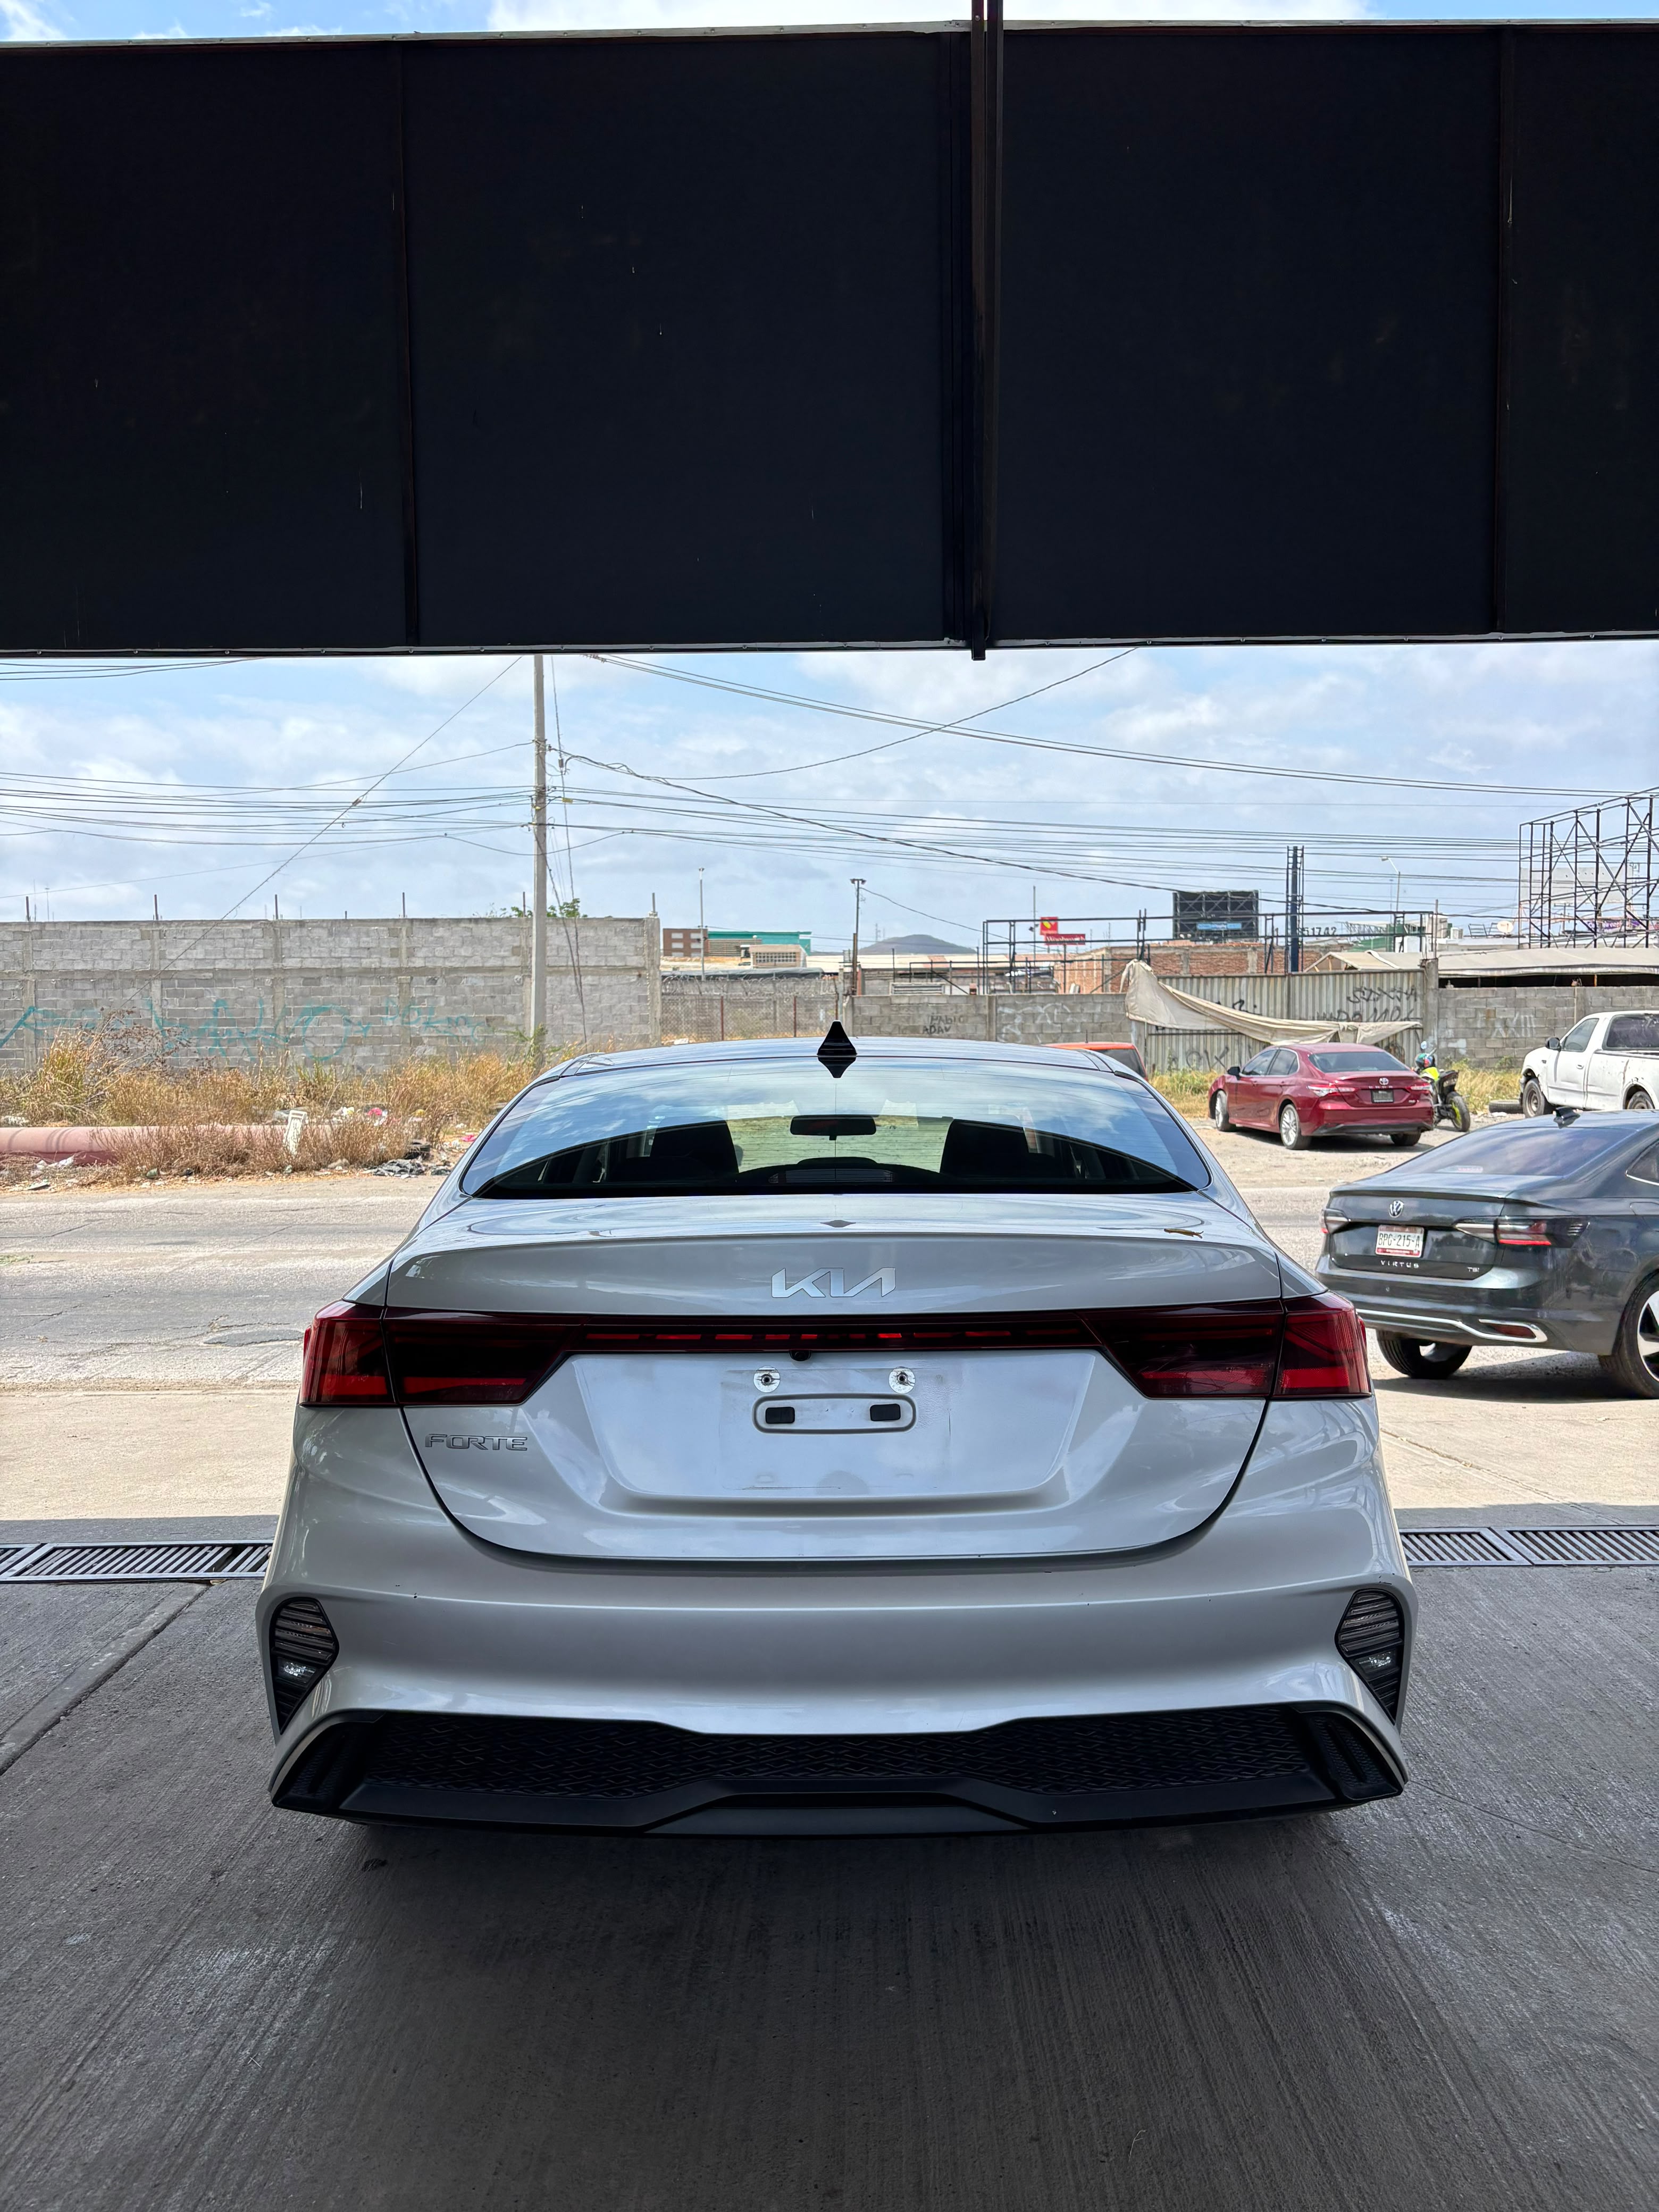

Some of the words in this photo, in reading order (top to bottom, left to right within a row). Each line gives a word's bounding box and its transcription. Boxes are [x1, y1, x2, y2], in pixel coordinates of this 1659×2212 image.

[1378, 1233, 1420, 1249] BPG-215-A
[1380, 1260, 1419, 1269] VIRTUS
[772, 1267, 896, 1298] KIA
[424, 1434, 528, 1451] FORTE
